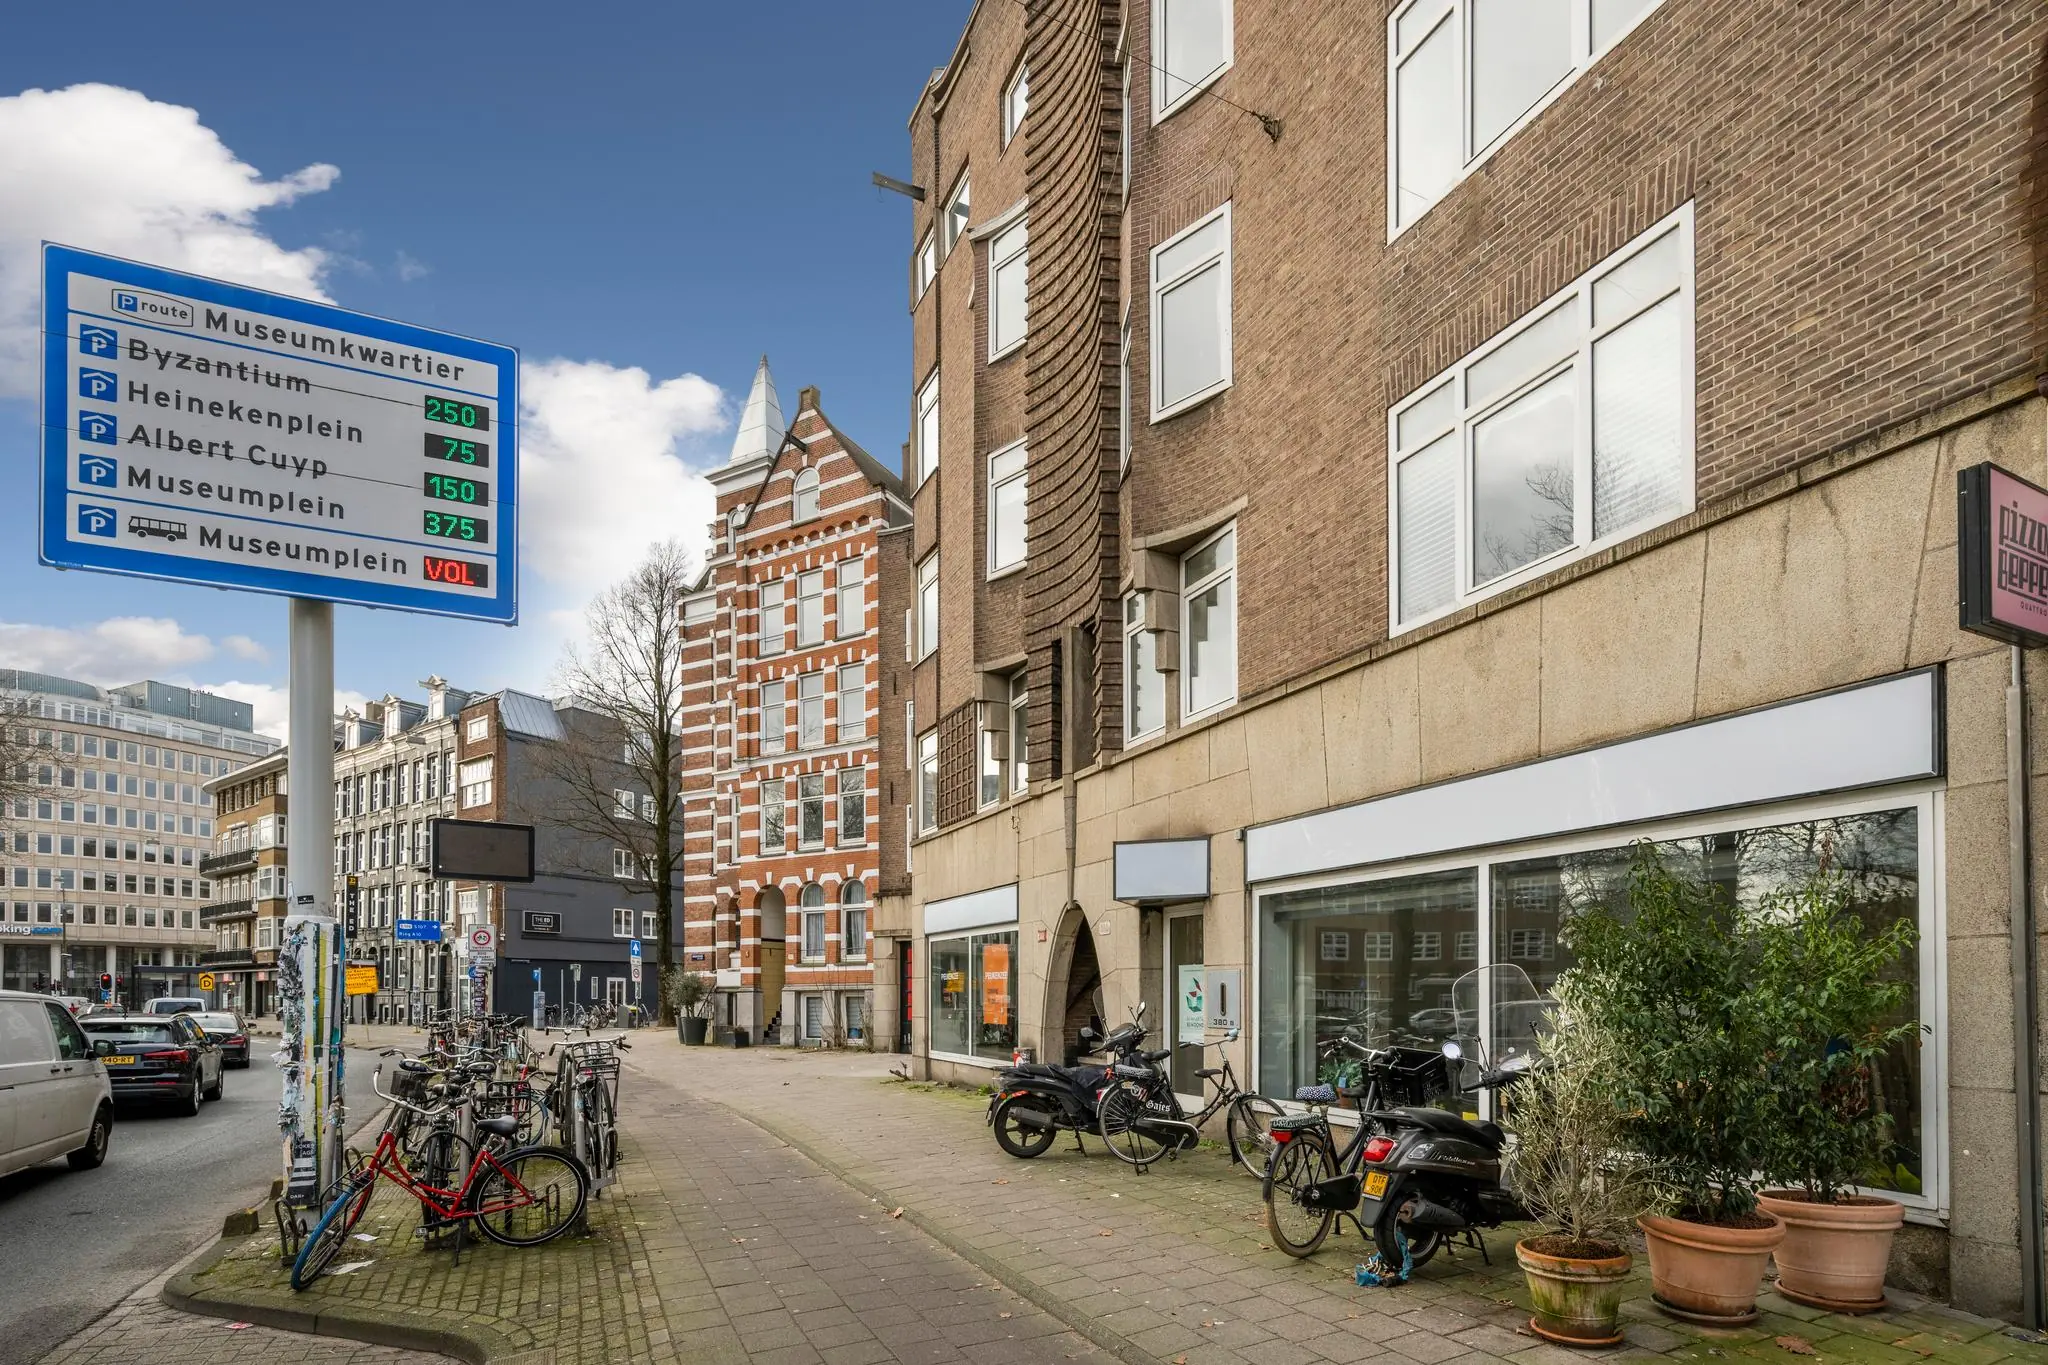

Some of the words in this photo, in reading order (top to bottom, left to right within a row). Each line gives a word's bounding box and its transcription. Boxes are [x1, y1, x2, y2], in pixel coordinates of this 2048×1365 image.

[141, 300, 188, 320] route
[205, 308, 464, 381] Museumkwartier
[129, 338, 310, 394] Byzantium
[128, 380, 363, 443] Heinekenplein
[426, 398, 476, 428] 250
[127, 424, 234, 461] Albert
[248, 444, 328, 480] Cuyp
[443, 438, 476, 465] 75
[128, 465, 345, 520] Museumplein
[428, 475, 475, 503] 150
[425, 512, 475, 541] 375
[200, 525, 408, 575] Museumplein
[424, 557, 475, 586] VOL
[2020, 600, 2048, 617] QUATTRO
